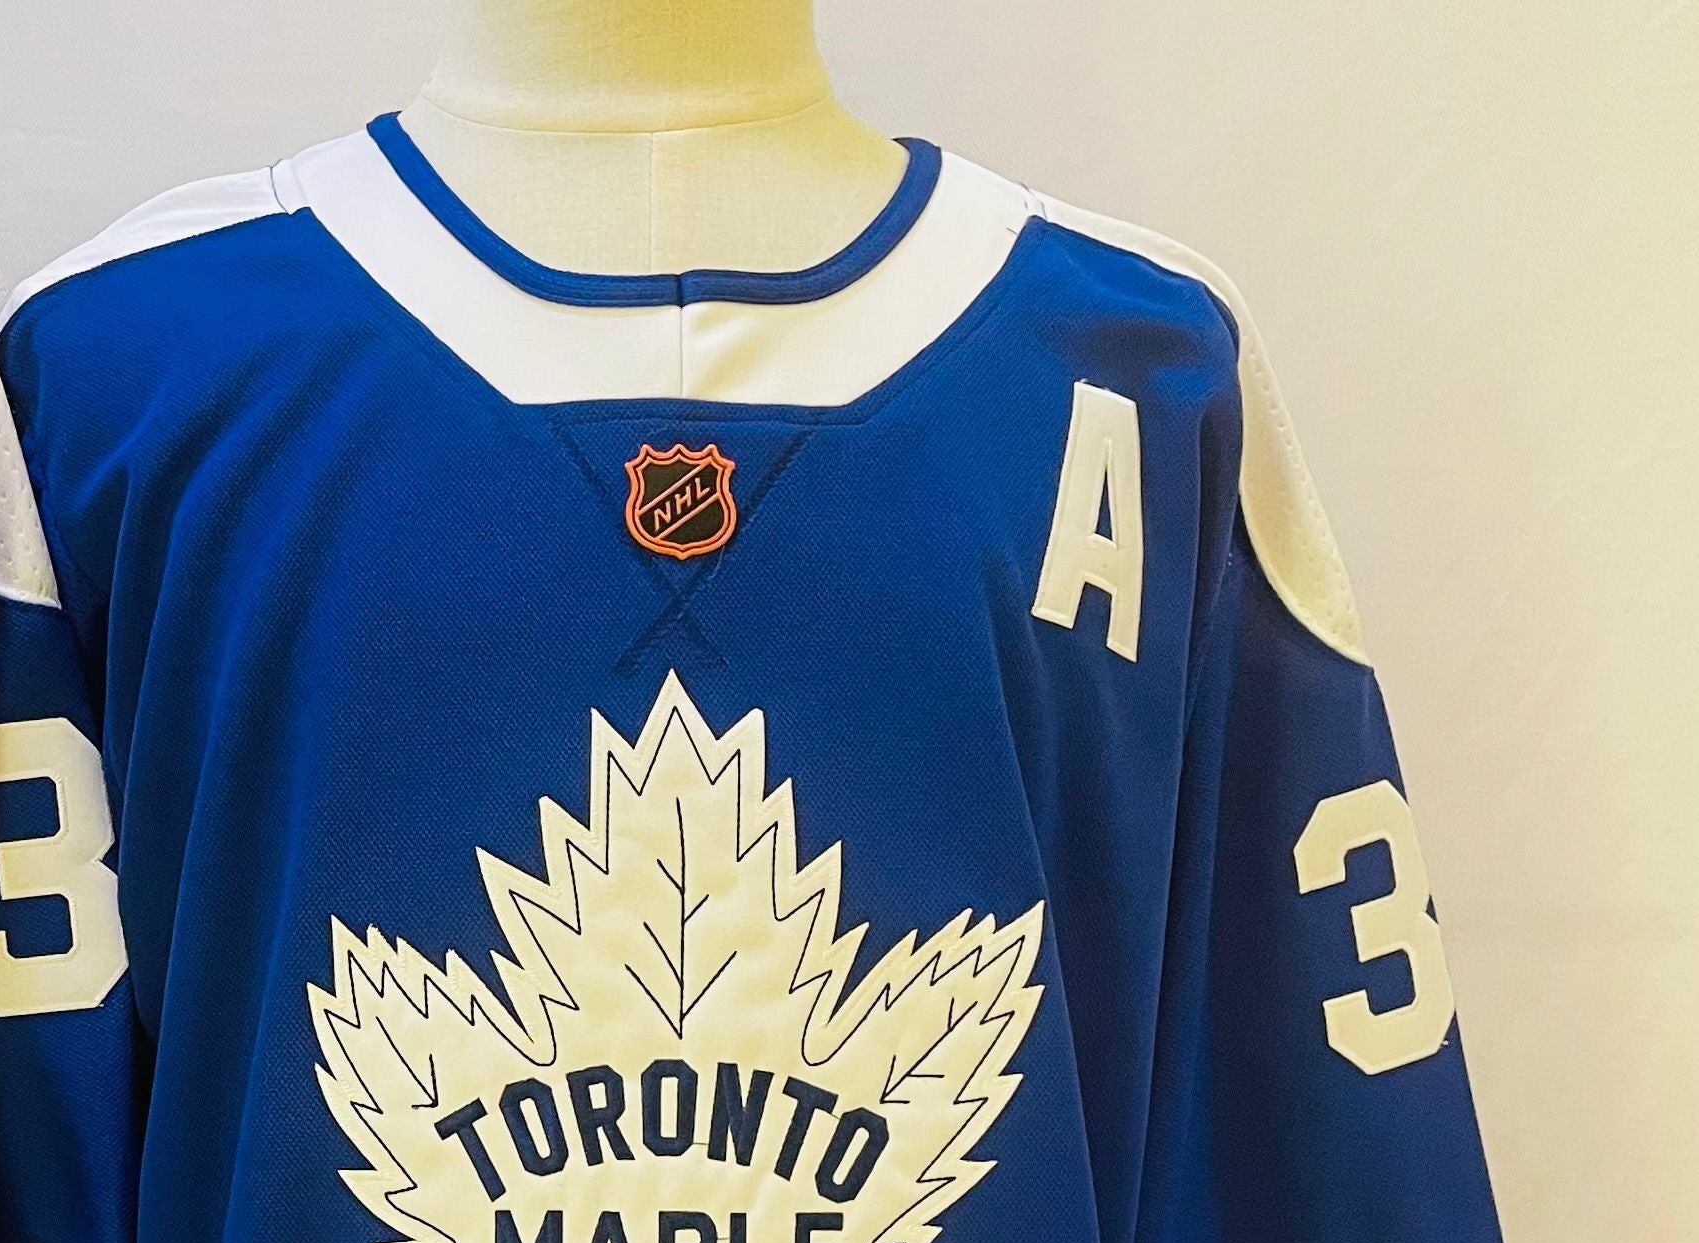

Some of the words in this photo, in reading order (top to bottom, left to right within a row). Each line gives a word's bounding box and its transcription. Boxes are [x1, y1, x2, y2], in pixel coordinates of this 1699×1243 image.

[653, 477, 710, 532] NHL
[1031, 381, 1144, 662] A
[1293, 779, 1455, 1076] 3
[435, 1058, 890, 1203] TORONTO
